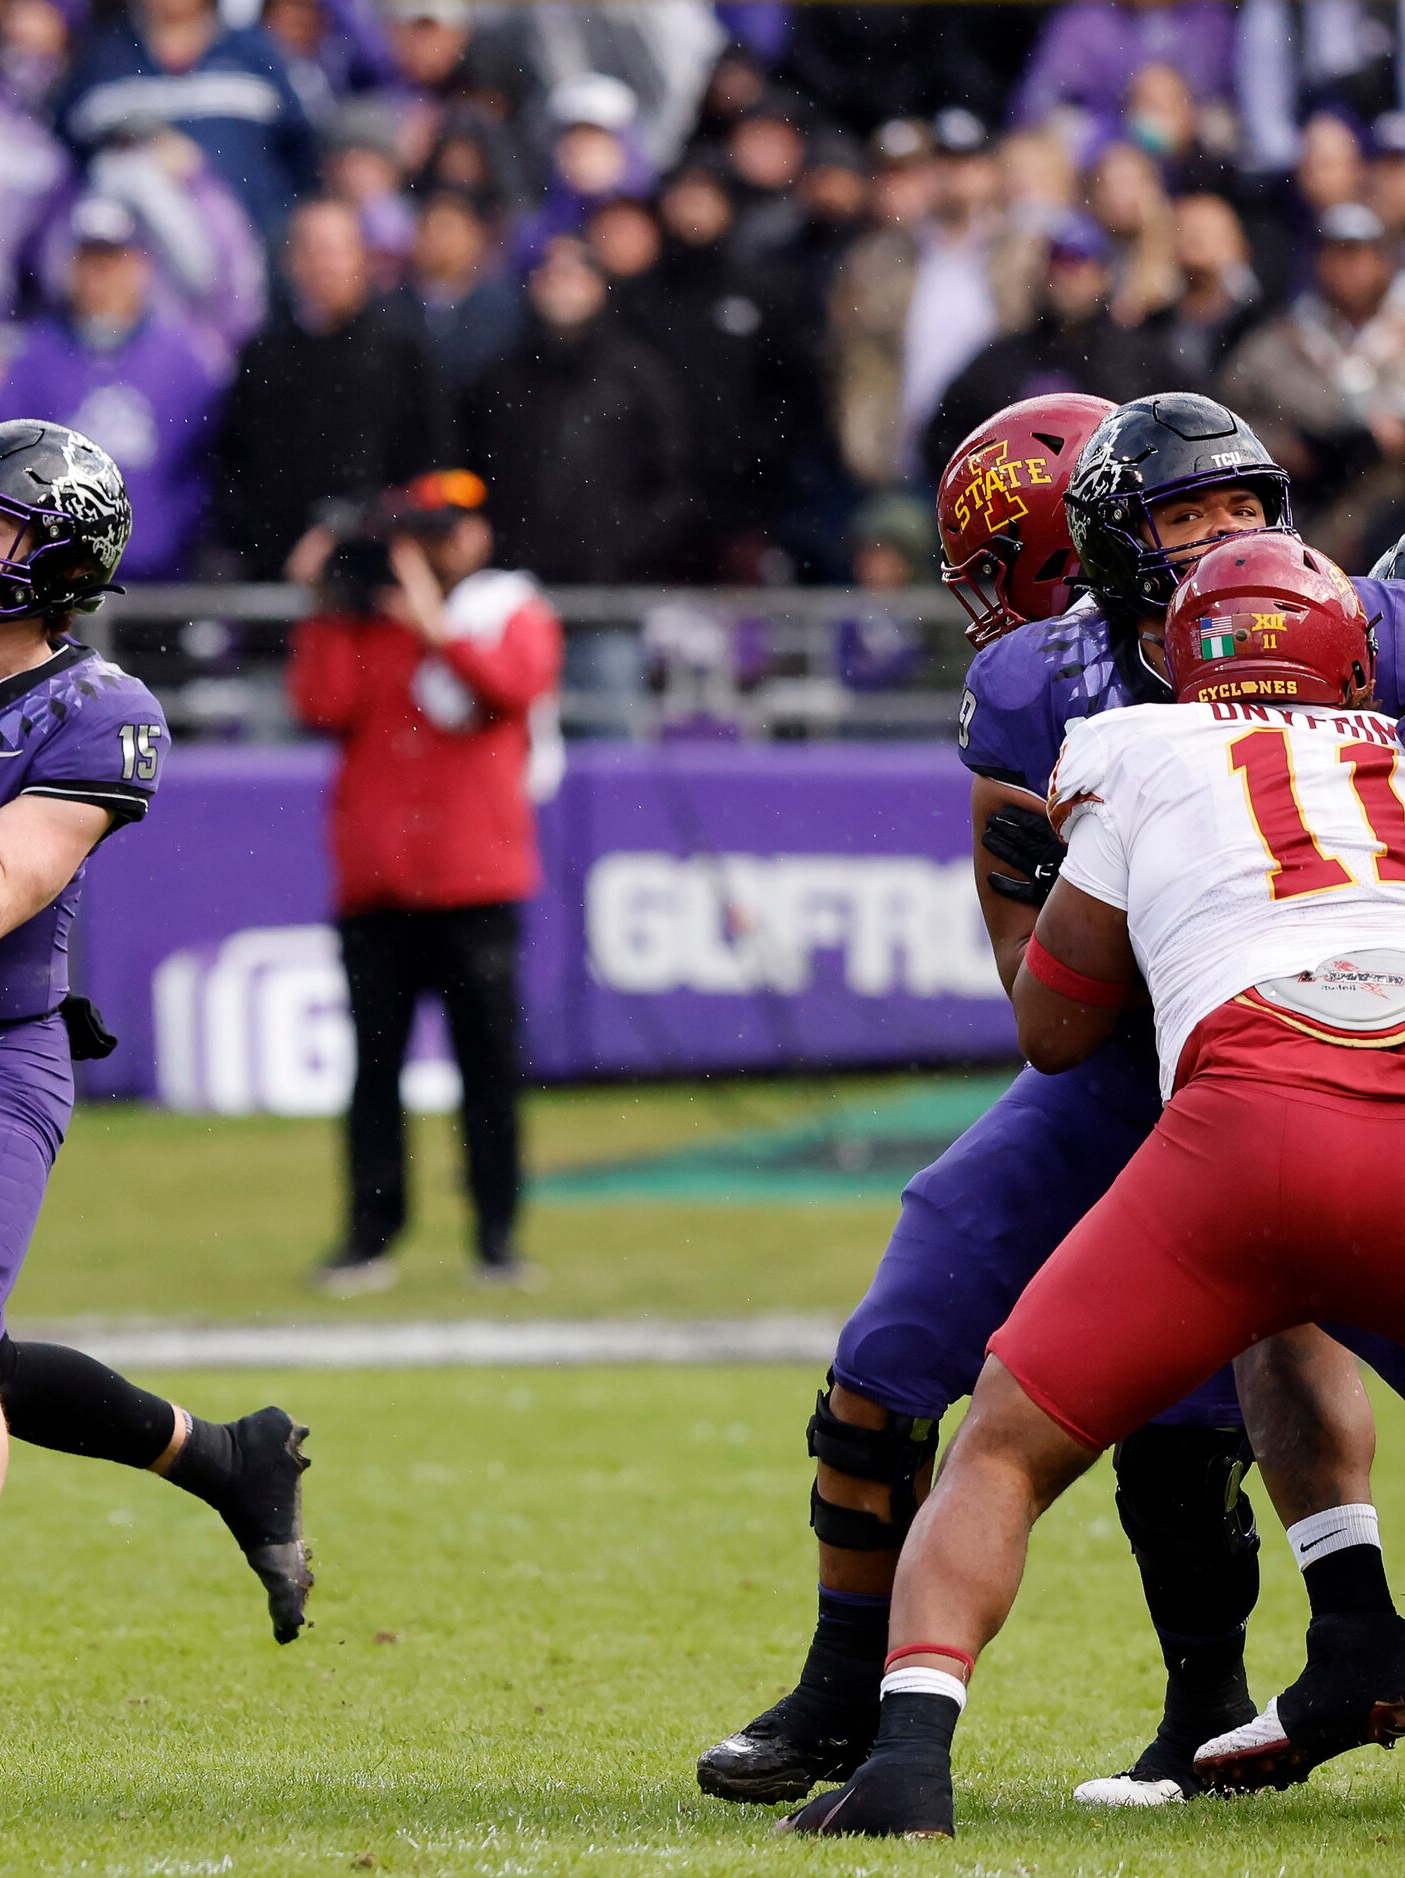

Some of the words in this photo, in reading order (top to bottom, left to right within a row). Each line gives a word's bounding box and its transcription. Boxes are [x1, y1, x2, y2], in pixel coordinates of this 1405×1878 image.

[1211, 451, 1242, 468] TCU
[954, 458, 1053, 531] STATE
[1251, 612, 1288, 632] XII
[1262, 633, 1277, 649] 11
[118, 724, 163, 782] 15
[1226, 727, 1405, 901] 11
